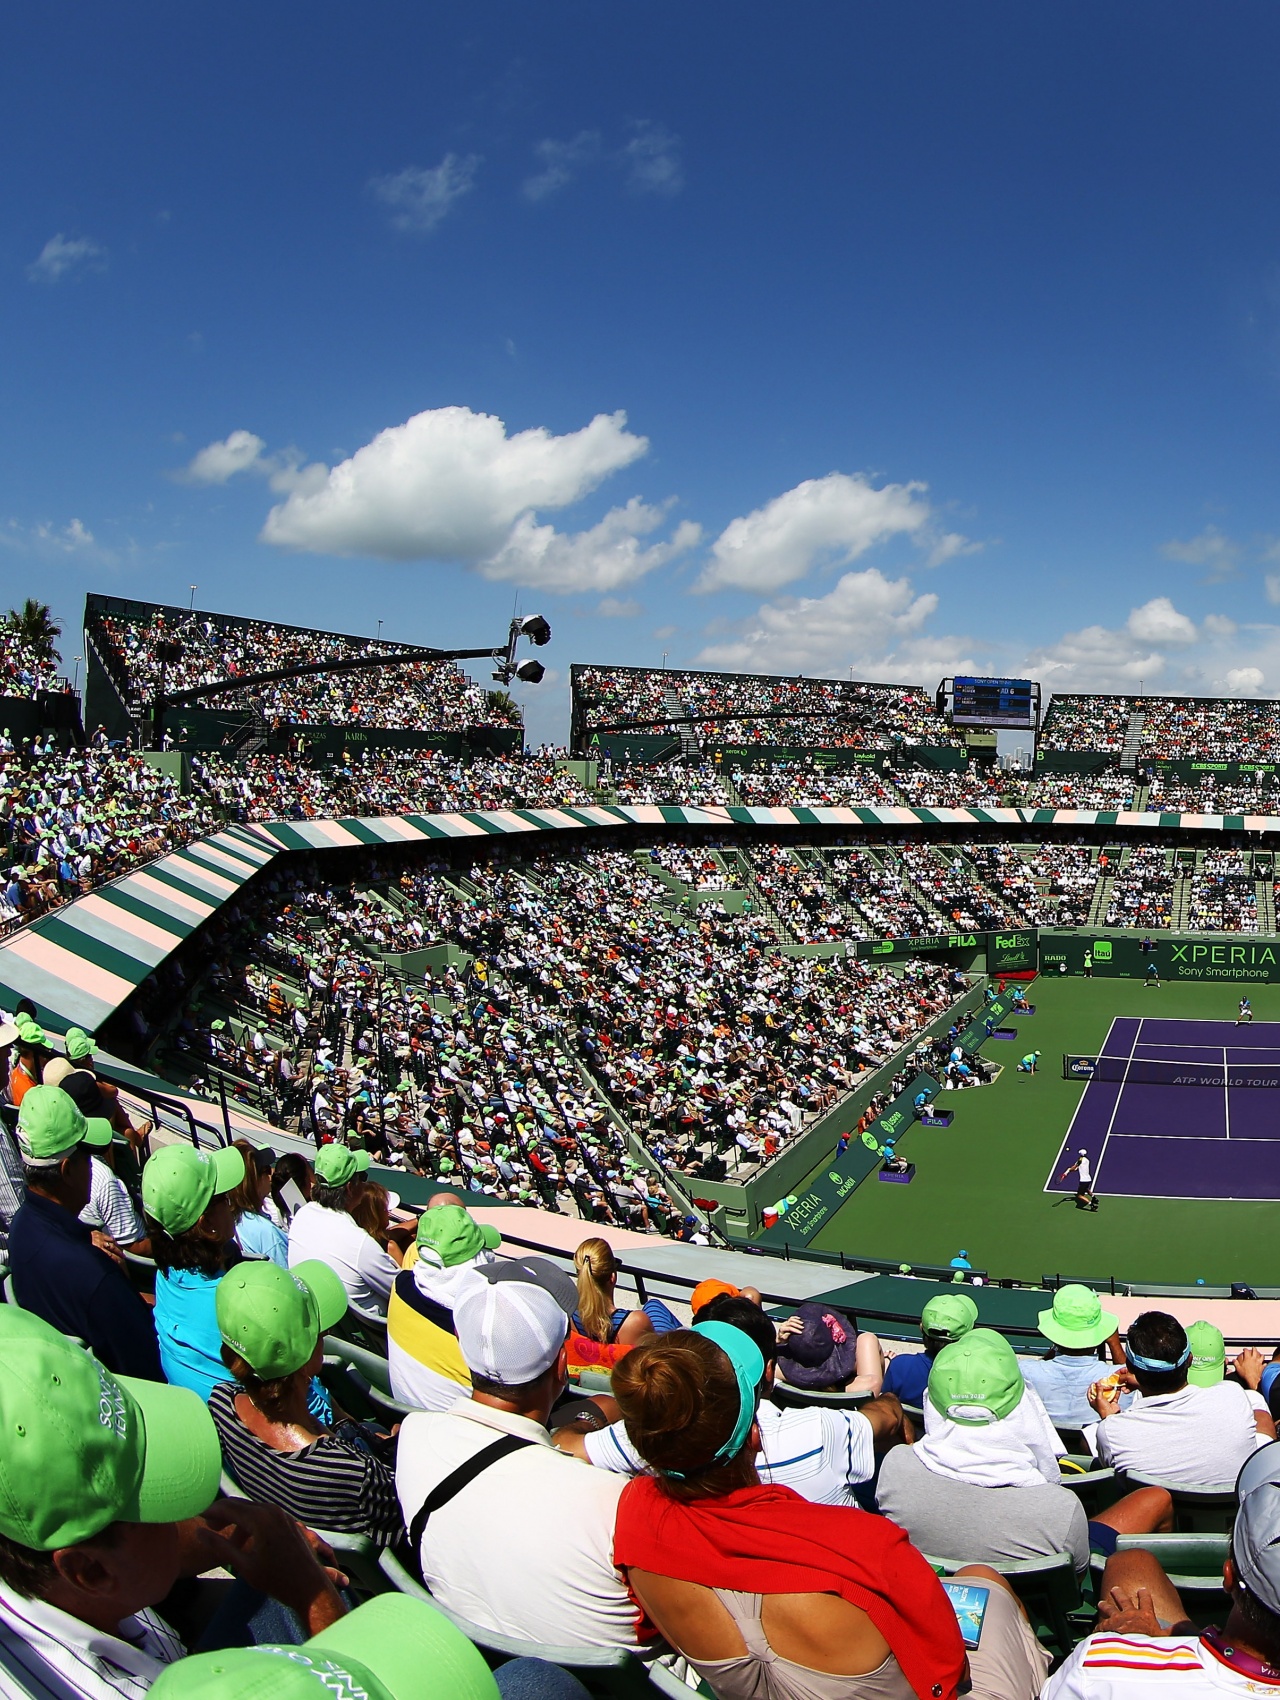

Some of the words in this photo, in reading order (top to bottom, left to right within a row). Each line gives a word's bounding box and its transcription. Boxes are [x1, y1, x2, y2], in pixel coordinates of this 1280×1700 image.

[515, 731, 522, 742] A
[591, 733, 600, 745] A
[960, 749, 967, 758] B
[1036, 751, 1044, 760] B
[908, 937, 940, 947] XPERIA
[949, 935, 977, 948] FILA
[995, 934, 1030, 949] FedEx
[1094, 949, 1111, 957] Itaú
[1170, 944, 1277, 965] XPERIA
[1178, 965, 1204, 978] Sony
[1205, 966, 1270, 979] Smartphone
[1071, 1063, 1095, 1072] Corona
[1173, 1076, 1196, 1084] ATP
[1200, 1077, 1243, 1086] WORLD
[1246, 1079, 1279, 1087] TOUR
[784, 1193, 822, 1231] XPERIA
